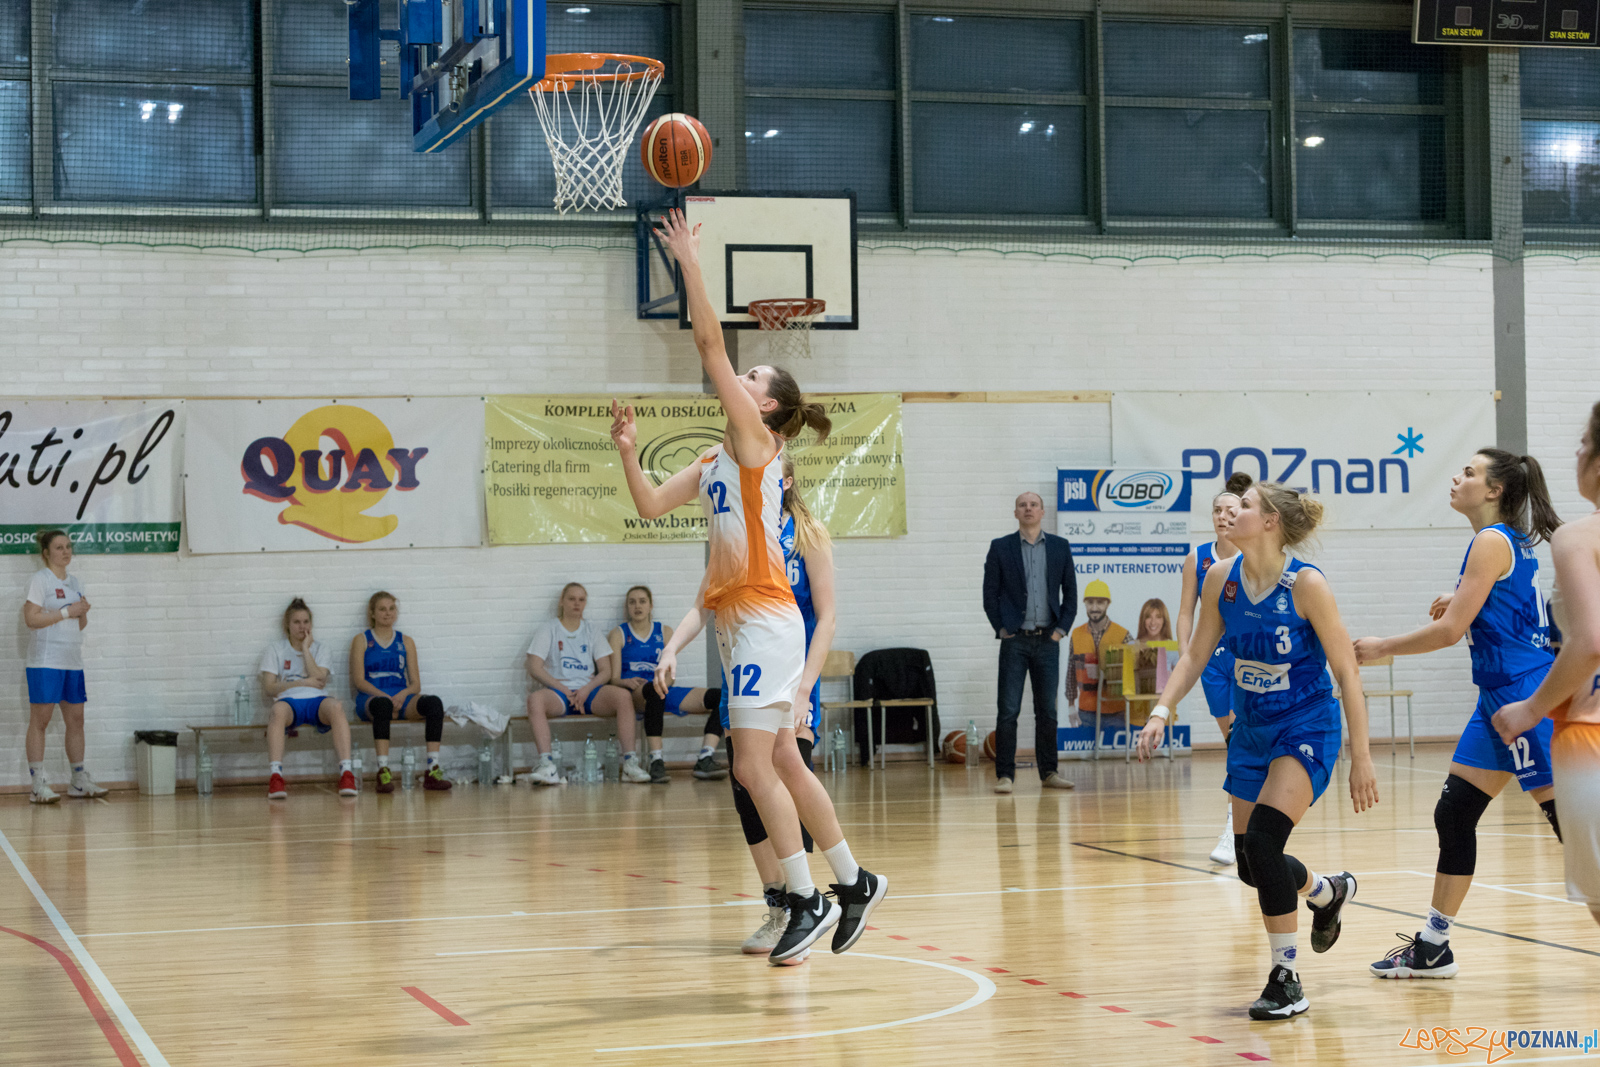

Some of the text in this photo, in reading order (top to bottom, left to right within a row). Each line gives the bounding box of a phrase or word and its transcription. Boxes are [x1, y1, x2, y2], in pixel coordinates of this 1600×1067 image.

[1442, 27, 1483, 37] STAN SETÓW
[1550, 30, 1590, 40] STAN SETÓW
[659, 138, 673, 180] molten
[680, 149, 689, 167] FIBA
[544, 404, 725, 418] KOMPLEKWA OBSŁUGA
[491, 436, 637, 453] Imprezy okolicznościo
[0, 409, 175, 521] uti.pl
[241, 436, 429, 504] QUAY
[492, 460, 590, 476] Catering dla firm
[493, 483, 617, 499] Posiłki regeneracyjne
[1064, 478, 1087, 503] psb
[1106, 483, 1164, 500] LOBO
[624, 513, 709, 529] www.barn
[0, 530, 179, 544] OSPOCZA I KOSMETYKI
[1069, 526, 1080, 536] 24
[1074, 564, 1184, 574] KLEP INTERNETOWY
[1275, 625, 1292, 655] 3
[731, 663, 762, 697] 12
[1508, 736, 1535, 771] 12
